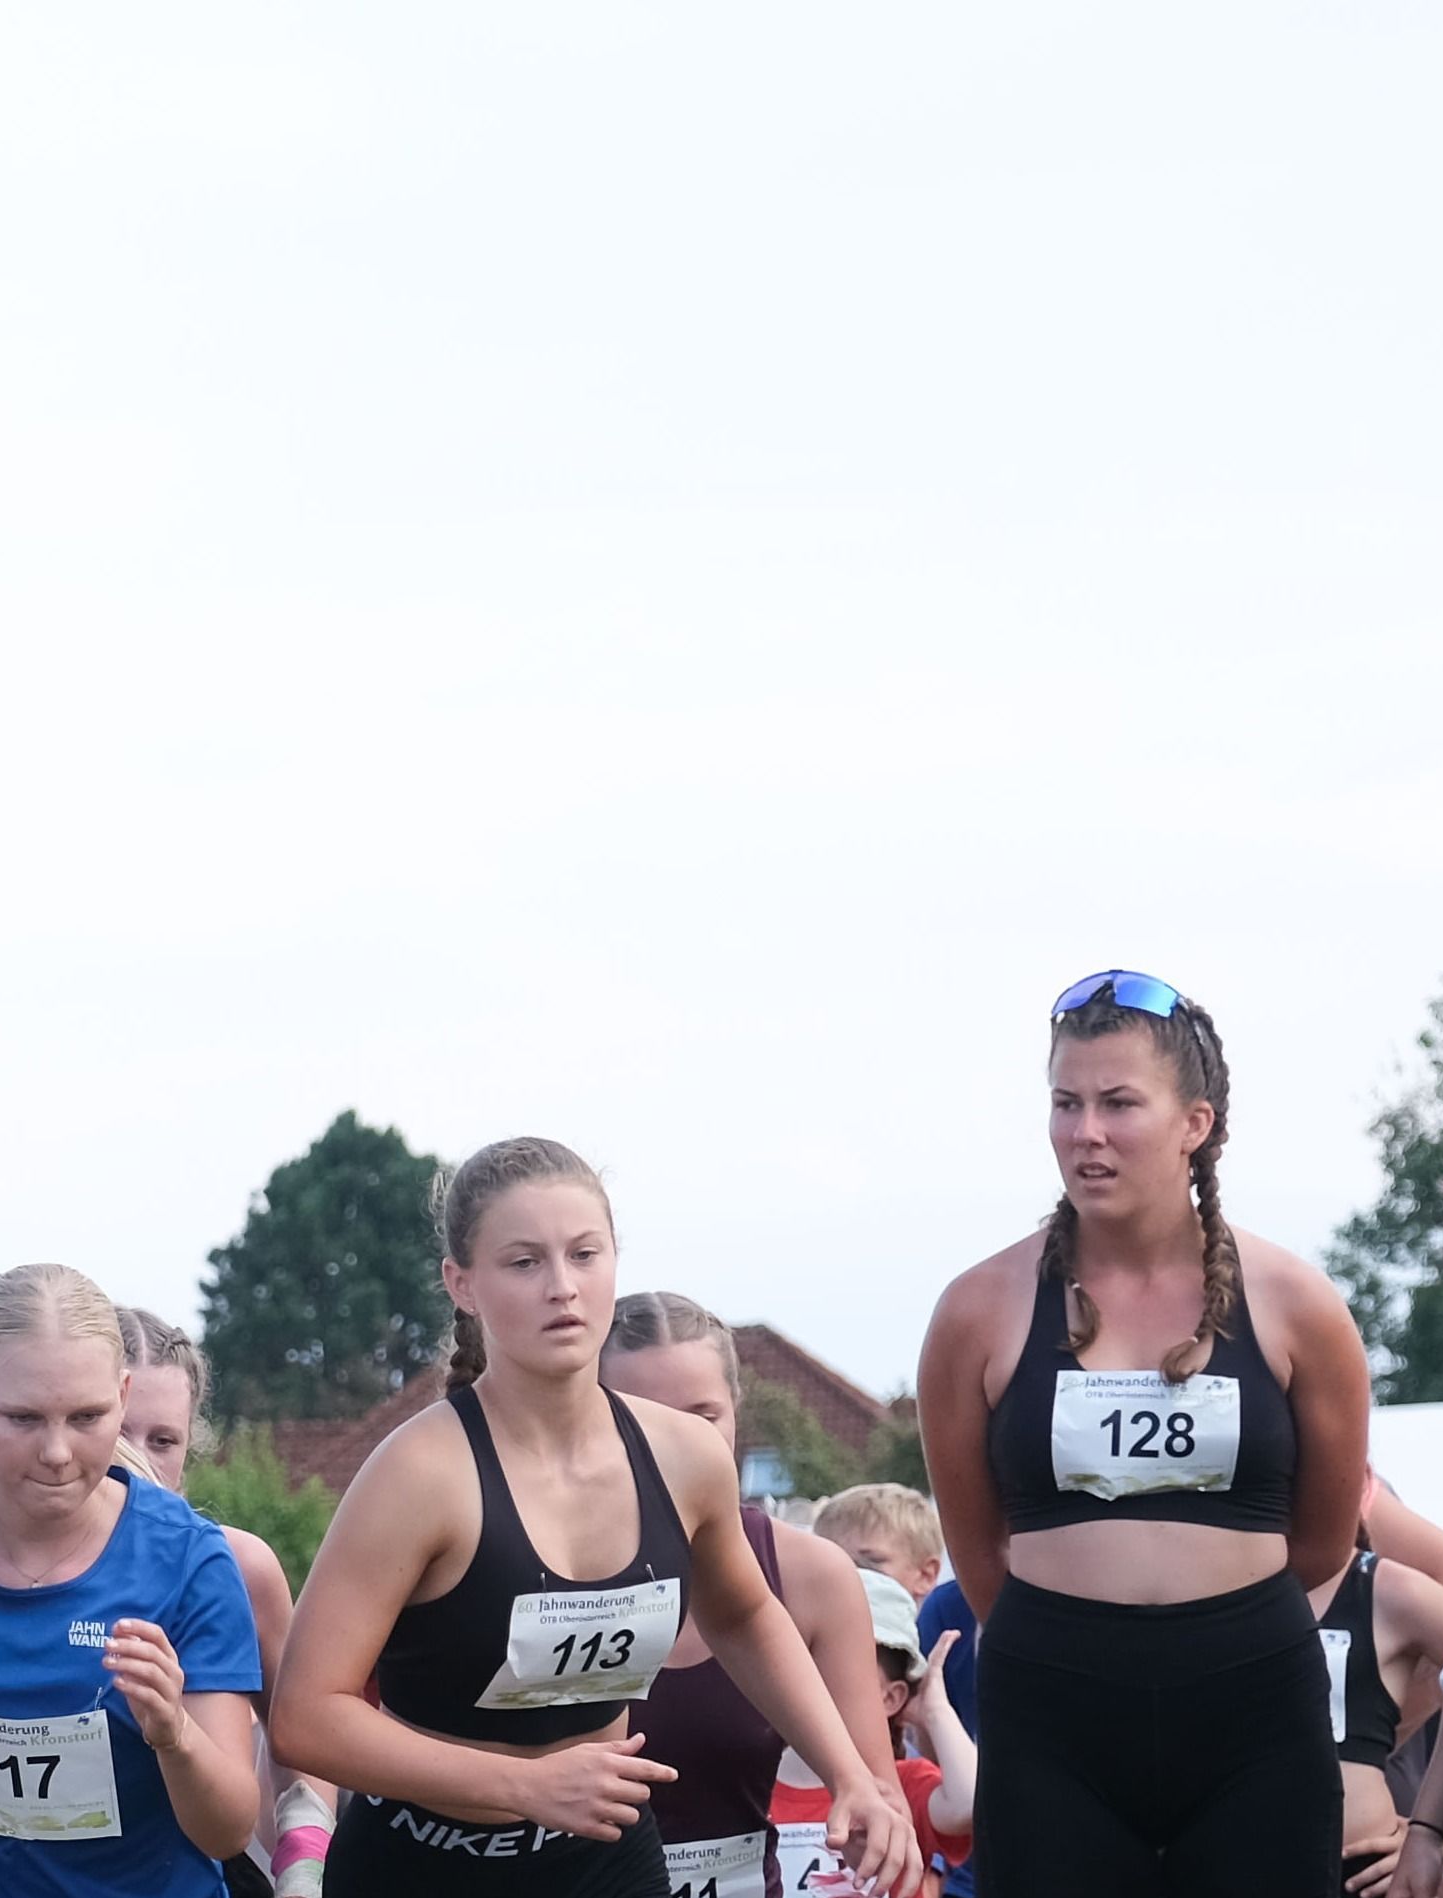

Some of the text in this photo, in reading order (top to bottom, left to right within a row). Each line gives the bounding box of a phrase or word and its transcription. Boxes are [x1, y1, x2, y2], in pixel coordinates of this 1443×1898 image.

[1100, 1409, 1195, 1458] 128
[518, 1594, 635, 1613] 60. Jahnwanderung
[69, 1620, 105, 1634] JAHN
[552, 1628, 635, 1676] 113
[30, 1728, 104, 1746] Kronstorf
[389, 1807, 525, 1857] NIKE
